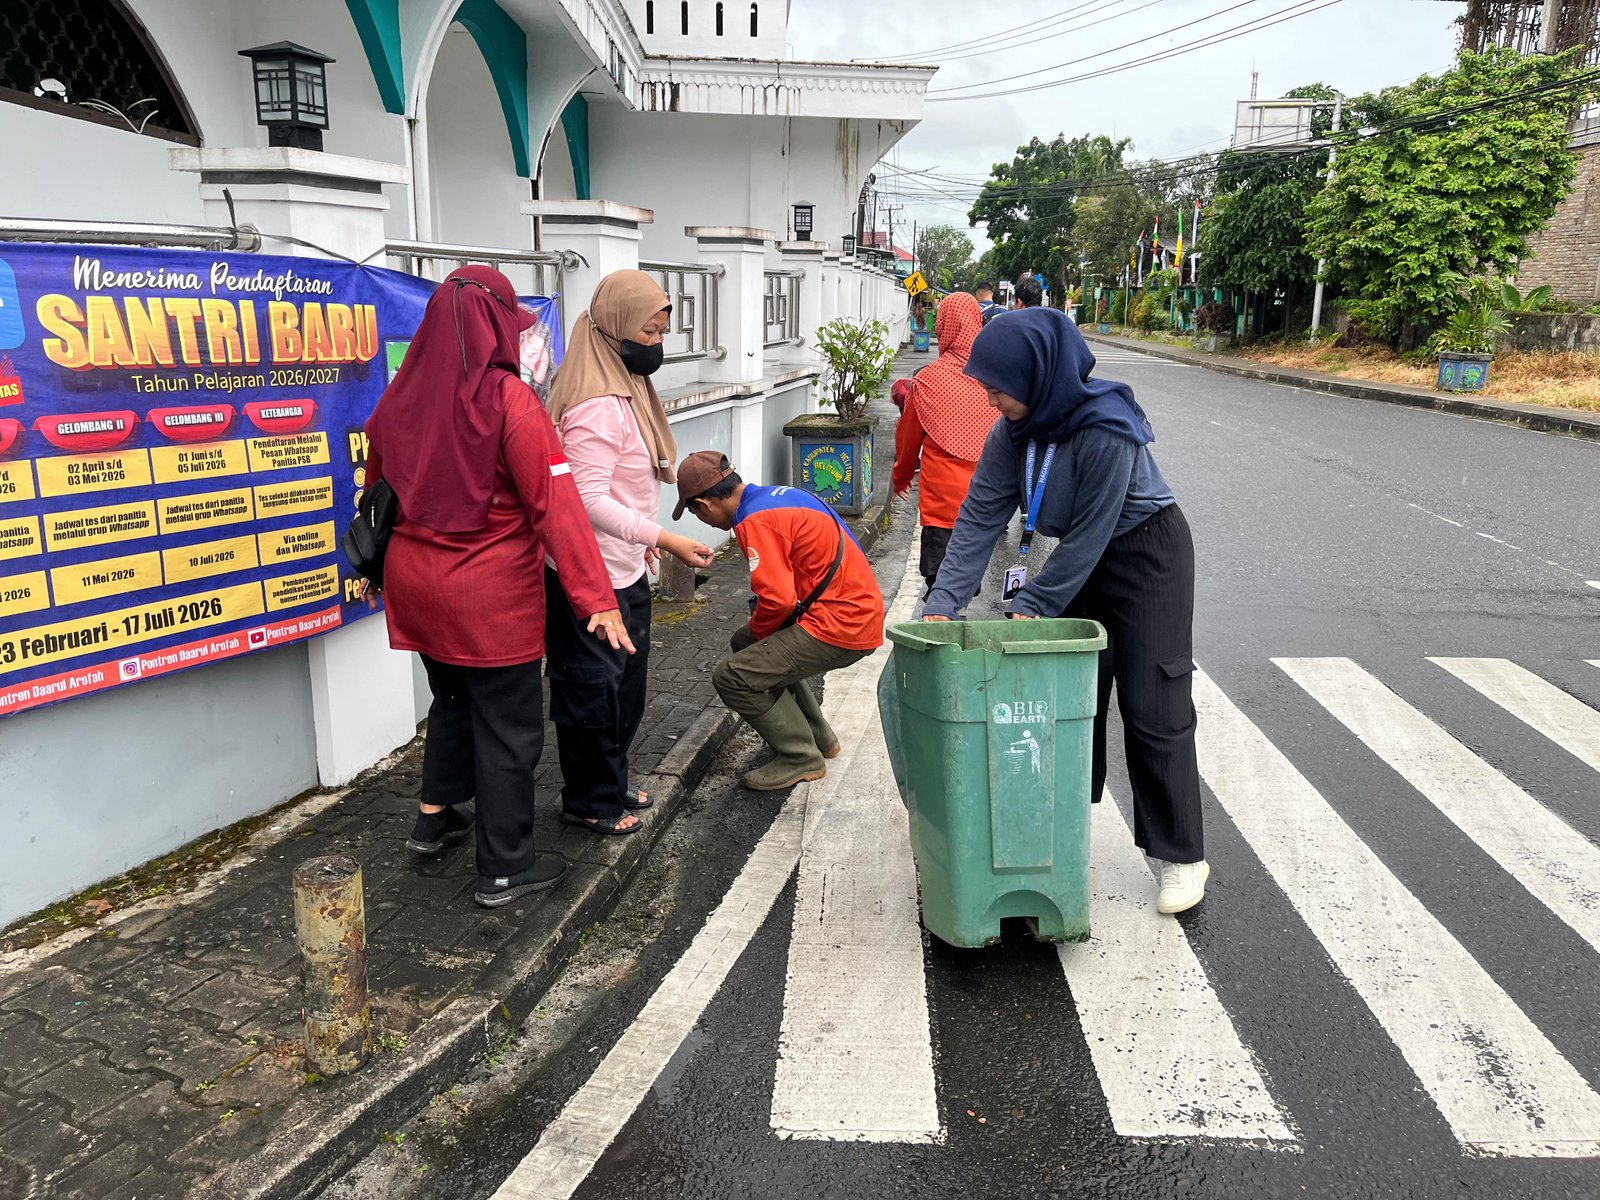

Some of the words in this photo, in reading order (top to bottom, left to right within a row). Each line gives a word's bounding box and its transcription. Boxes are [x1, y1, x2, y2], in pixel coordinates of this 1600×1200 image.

[73, 255, 203, 291] Menerima
[210, 262, 334, 301] Pendaftaran
[36, 293, 261, 369] SANTRI
[267, 300, 378, 365] BARU
[131, 374, 189, 393] Tahun
[194, 372, 265, 393] Pelajaran
[269, 368, 340, 387] 2026/2027
[0, 383, 19, 398] TAS
[164, 413, 212, 426] GELOMBANG
[214, 412, 224, 423] III
[260, 407, 303, 419] KETERANGAN
[57, 420, 113, 435] GELOMBANG
[115, 419, 124, 430] II
[253, 438, 296, 449] Pendaftaran
[296, 434, 322, 444] Melalui
[178, 452, 188, 462] 01
[191, 450, 208, 461] Juni
[208, 449, 223, 459] s/d
[261, 448, 283, 458] Pesan
[284, 445, 319, 456] Whatsapp
[67, 464, 80, 474] 02
[82, 461, 104, 473] April
[106, 459, 123, 470] s/d
[177, 464, 189, 473] 05
[190, 462, 204, 472] Juli
[205, 460, 226, 471] 2026
[272, 457, 297, 467] Panitia
[297, 455, 311, 464] PSB
[67, 475, 81, 486] 03
[82, 473, 100, 484] Mei
[101, 470, 125, 482] 2026
[814, 462, 843, 482] BELITUNG
[0, 482, 16, 494] 26
[166, 503, 191, 515] Jadwal
[192, 502, 204, 511] tes
[205, 500, 219, 509] dari
[220, 496, 245, 508] panitia
[54, 519, 84, 531] Jadwal
[85, 517, 99, 527] tes
[100, 514, 117, 524] dari
[118, 510, 146, 522] panitia
[165, 512, 193, 525] melalui
[195, 511, 212, 521] grup
[213, 505, 248, 517] Whatsapp
[53, 528, 86, 541] melalui
[87, 526, 107, 537] grup
[109, 519, 150, 533] Whatsapp
[283, 535, 296, 544] Via
[296, 532, 319, 542] online
[0, 536, 34, 549] atsapp
[189, 557, 198, 567] 10
[200, 553, 214, 566] Juli
[214, 550, 235, 563] 2026
[275, 547, 291, 555] dan
[81, 576, 91, 587] 11
[92, 573, 110, 585] Mei
[111, 568, 135, 581] 2026
[4, 588, 31, 602] 2026
[0, 641, 16, 664] 3
[20, 622, 108, 659] Februari
[121, 615, 140, 637] 17
[144, 607, 175, 633] Juli
[177, 597, 223, 624] 2026
[266, 625, 298, 640] Pontren
[298, 617, 321, 632] Daarul
[321, 611, 340, 625] Arofah
[141, 653, 178, 671] Pontren
[179, 645, 209, 662] Daarul
[210, 637, 240, 655] Arofah
[0, 689, 30, 707] ntren
[32, 680, 67, 698] Daarul
[69, 671, 104, 689] Arofah
